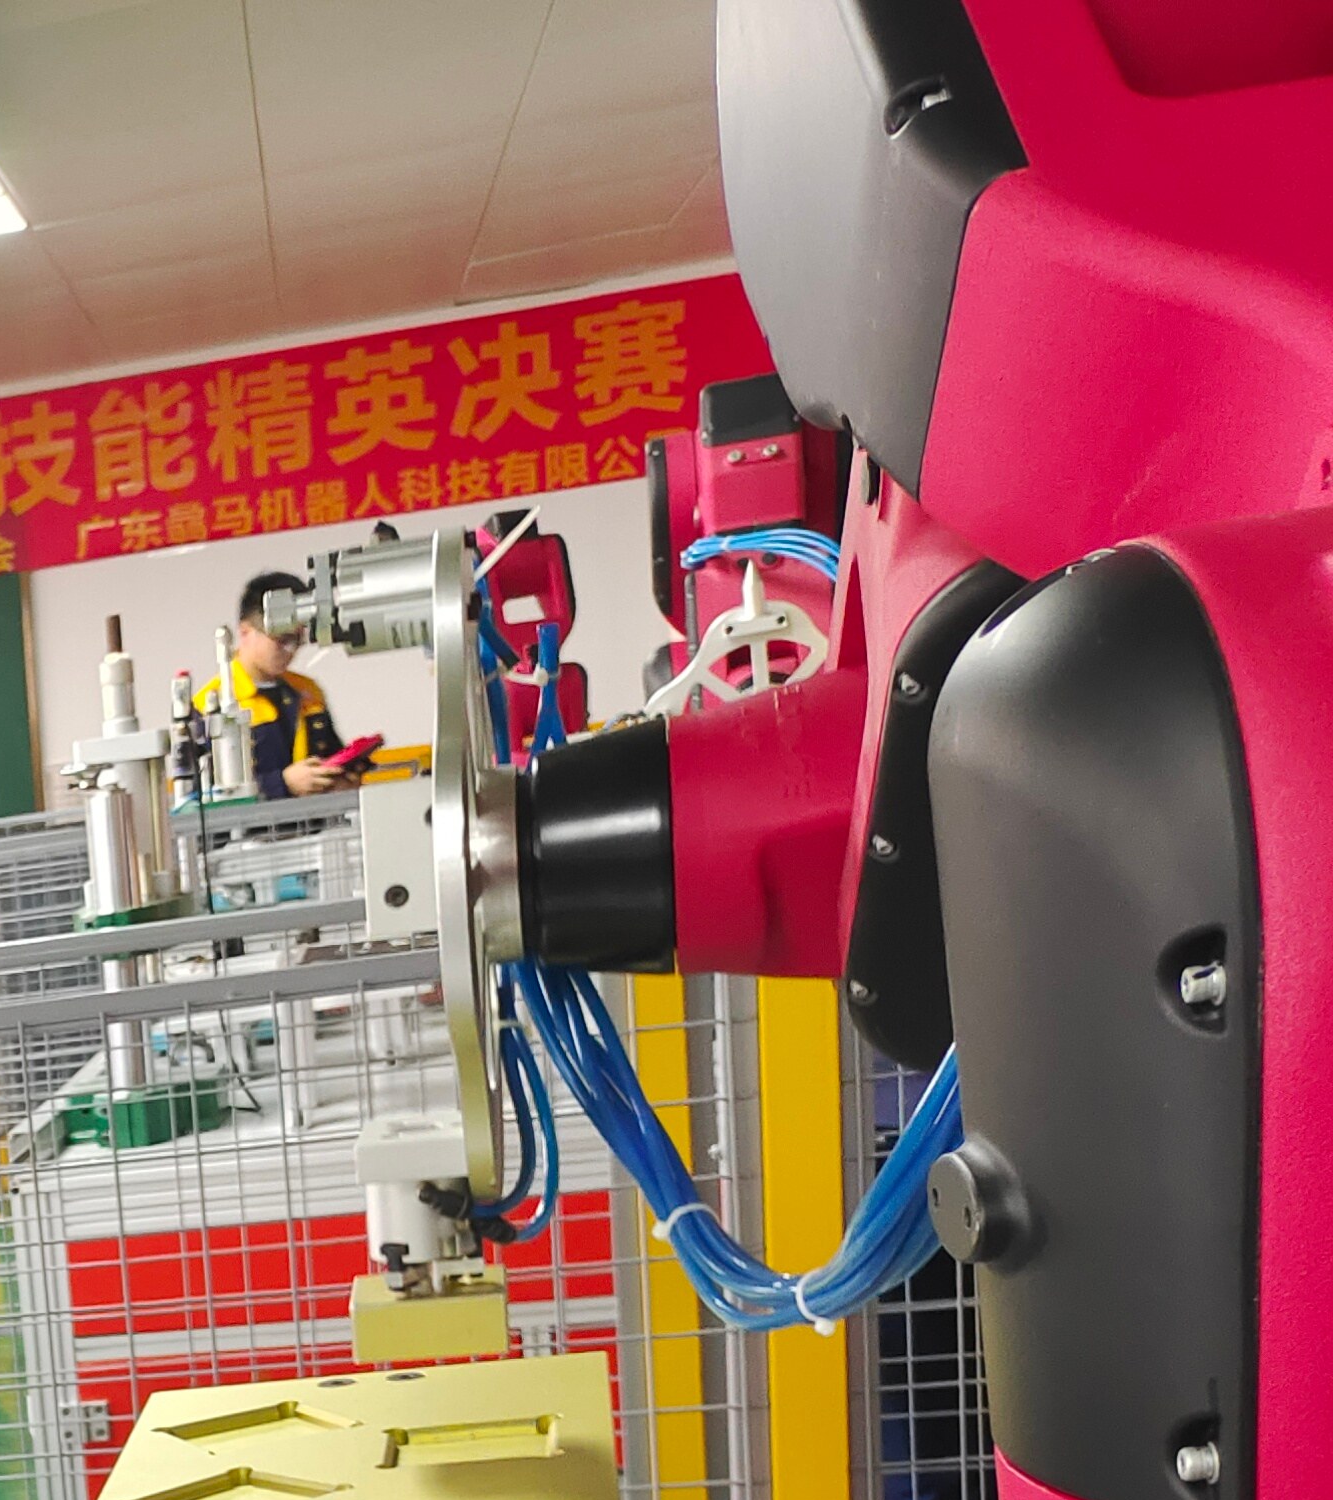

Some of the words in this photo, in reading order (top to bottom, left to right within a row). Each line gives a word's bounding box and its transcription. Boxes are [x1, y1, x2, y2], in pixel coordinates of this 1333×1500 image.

[75, 428, 685, 560] 广东骉马机器人科技有限公
